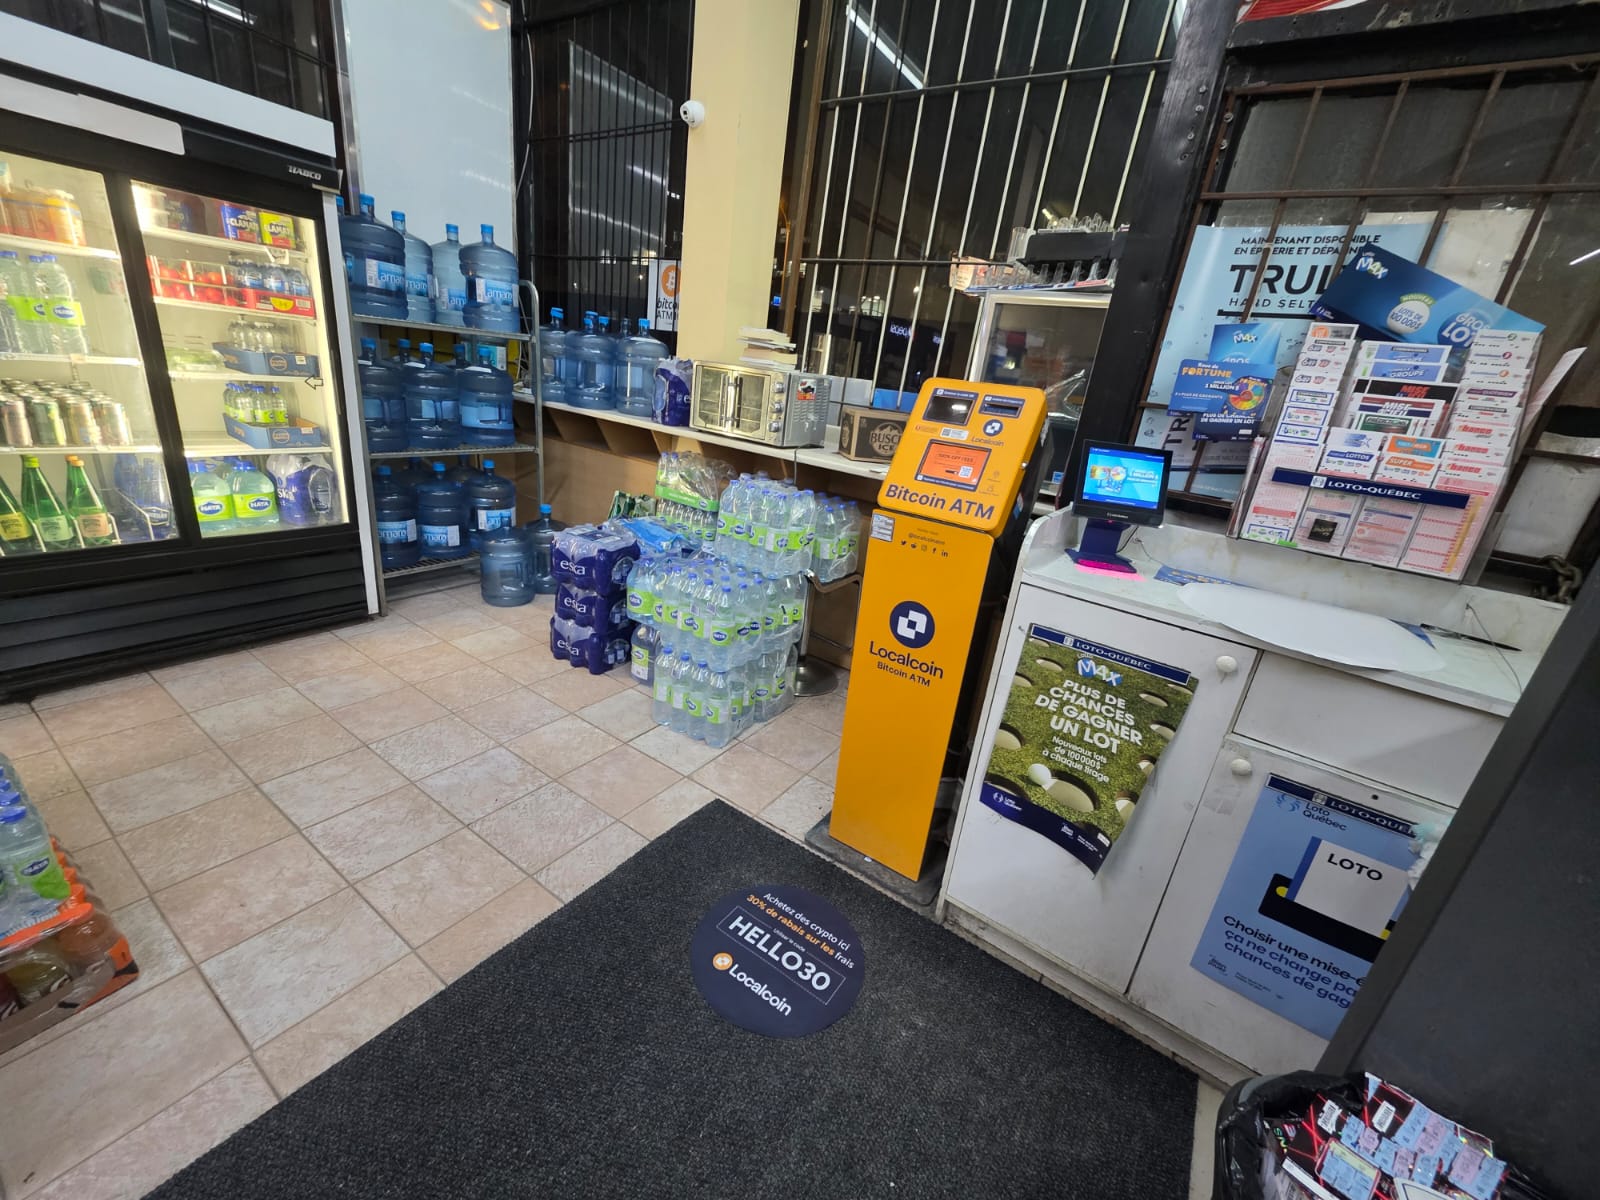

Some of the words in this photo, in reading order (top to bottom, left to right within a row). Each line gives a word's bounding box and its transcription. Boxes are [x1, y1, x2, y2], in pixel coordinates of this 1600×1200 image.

[1241, 236, 1312, 244] MAINENANT
[1181, 367, 1232, 378] FORTUNE
[885, 484, 946, 510] Bitcoin
[950, 498, 996, 520] ATM
[1328, 481, 1422, 500] LOTO-QUÉBEC
[870, 641, 944, 679] Localcoin
[878, 661, 907, 678] Bitcoin
[909, 673, 930, 687] ATM
[1078, 658, 1120, 686] MAX
[1050, 687, 1134, 726] CHANCES
[1063, 680, 1100, 700] PLUS
[1105, 694, 1126, 710] DE
[1035, 694, 1060, 712] DE
[1062, 706, 1142, 746] GAGNER
[1050, 716, 1079, 736] UN
[1084, 728, 1120, 754] LOT
[1302, 810, 1348, 831] Québec
[1305, 803, 1330, 816] Loto
[1327, 853, 1383, 881] LOTO
[746, 894, 767, 910] 30%
[766, 907, 778, 918] de
[778, 916, 805, 936] rabais
[804, 934, 821, 944] sur
[834, 952, 854, 968] frais
[763, 893, 796, 916] Achetez
[794, 913, 810, 926] des
[810, 923, 838, 943] crypto
[838, 940, 851, 951] ici
[1224, 915, 1276, 945] Choisir
[1278, 941, 1309, 962] une
[728, 915, 831, 991] HELLO30
[1224, 942, 1292, 980] chances
[1293, 974, 1314, 992] de
[1225, 930, 1245, 944] ça
[1249, 940, 1267, 954] ne
[1268, 948, 1332, 985] change
[728, 964, 792, 1016] Localcoin
